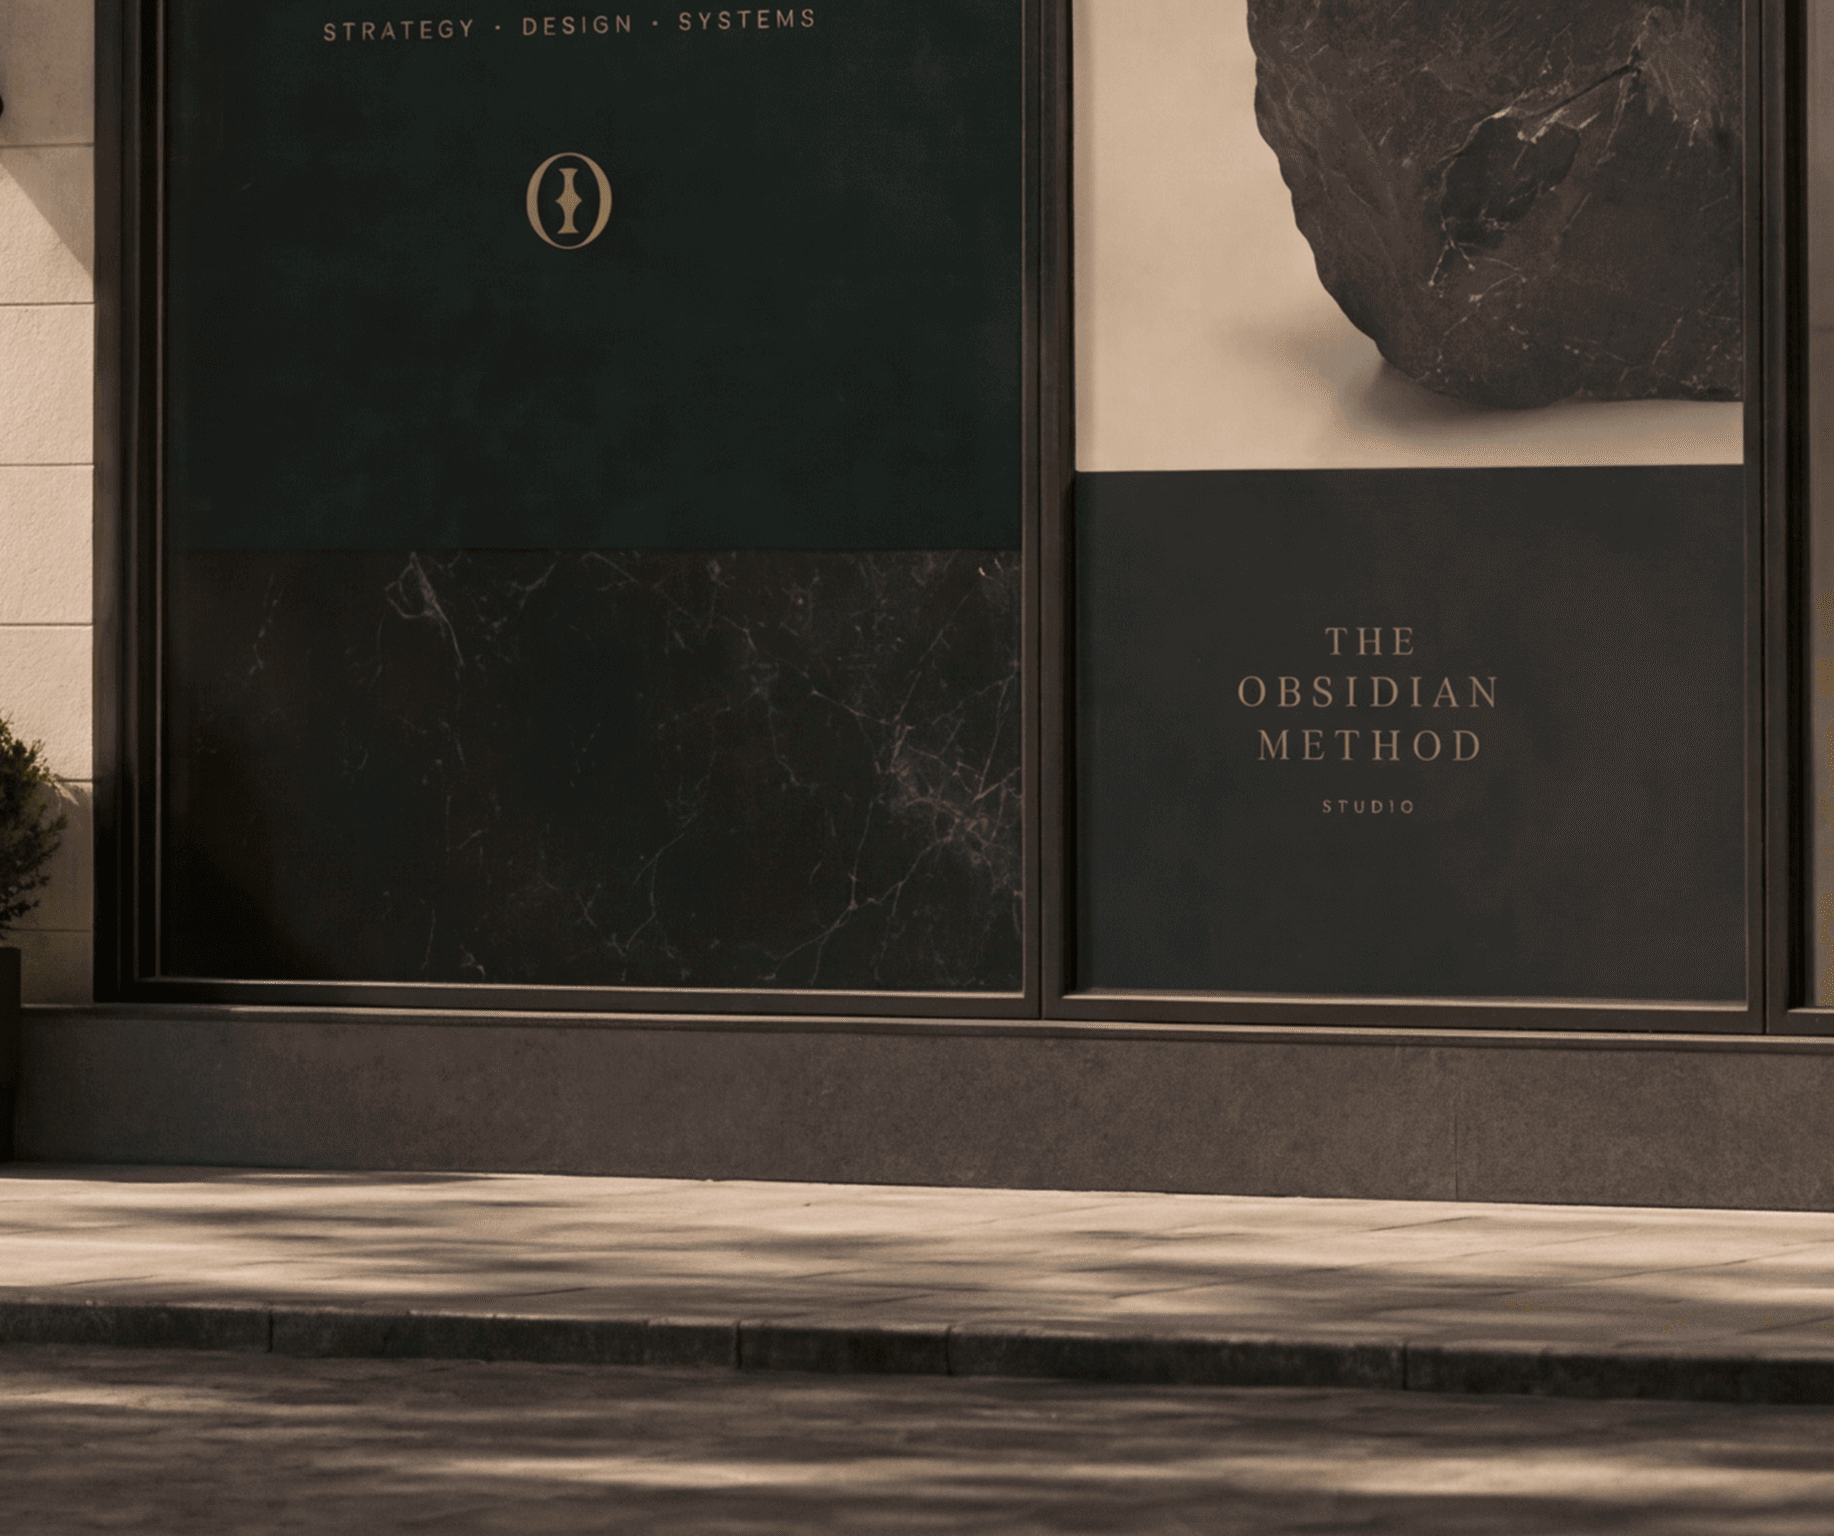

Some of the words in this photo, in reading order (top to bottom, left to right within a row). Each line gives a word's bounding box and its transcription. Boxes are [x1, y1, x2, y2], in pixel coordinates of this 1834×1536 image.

[323, 18, 474, 42] STRATEGY
[522, 14, 631, 37] DESIGN
[678, 8, 815, 32] SYSTEMS
[1325, 626, 1414, 656] THE
[1237, 675, 1497, 708] OBSIDIAN
[1258, 729, 1480, 762] METHOD
[1322, 799, 1414, 815] STUDIO
